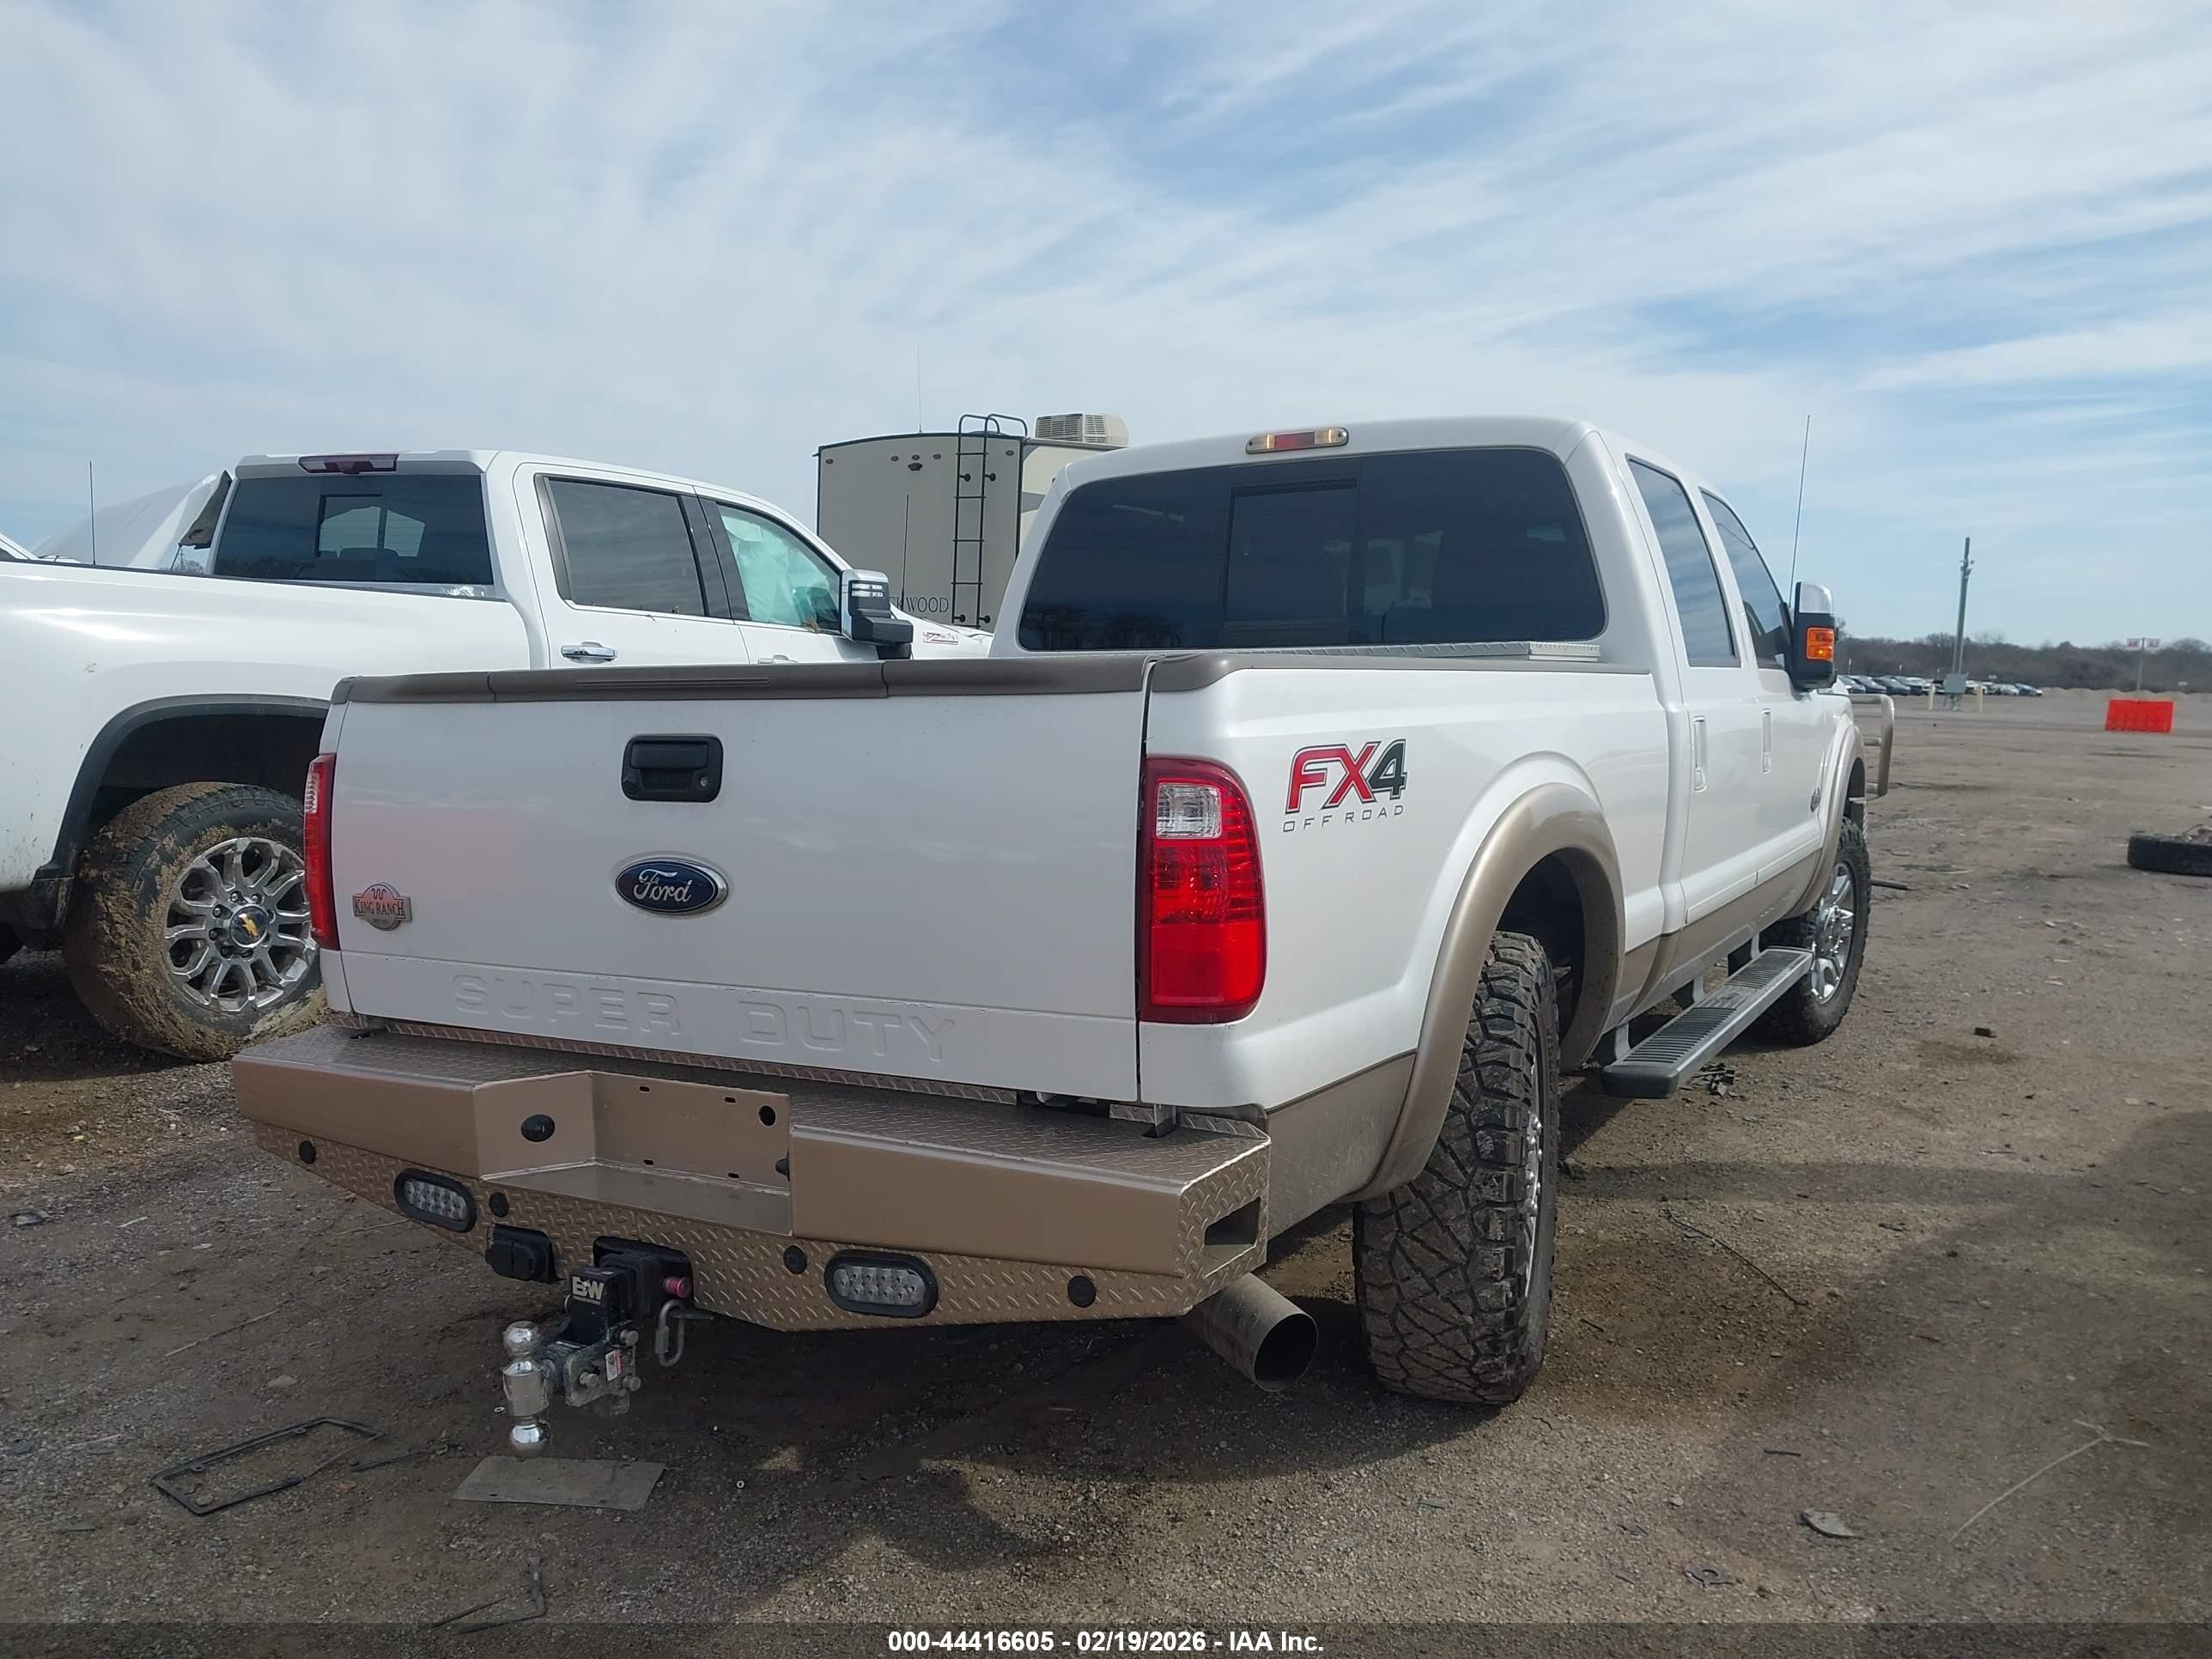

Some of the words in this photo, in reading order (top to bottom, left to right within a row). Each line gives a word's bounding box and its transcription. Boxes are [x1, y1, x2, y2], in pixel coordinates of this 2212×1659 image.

[1285, 738, 1407, 814] FX4
[1282, 814, 1333, 833] OFF
[1344, 805, 1405, 824] ROAD
[633, 868, 693, 902] Ford
[355, 898, 374, 915] KING
[375, 900, 405, 916] RANCH
[452, 973, 683, 1036] SUPER
[738, 1000, 957, 1063] DUTY
